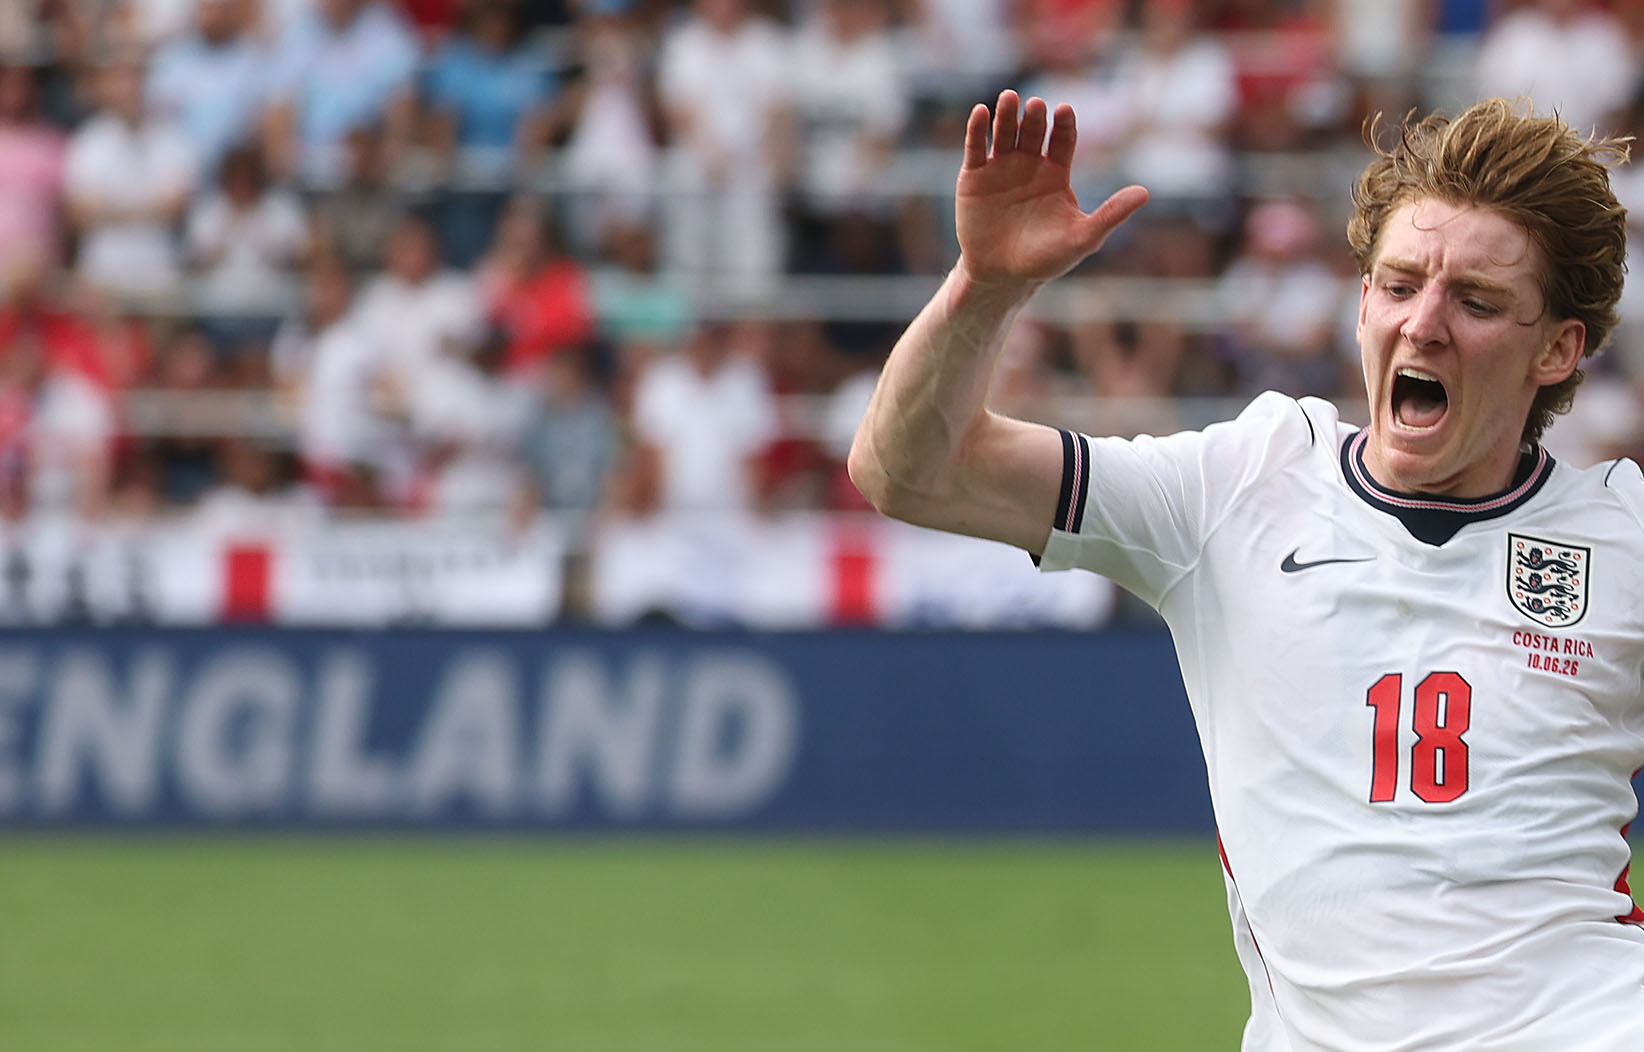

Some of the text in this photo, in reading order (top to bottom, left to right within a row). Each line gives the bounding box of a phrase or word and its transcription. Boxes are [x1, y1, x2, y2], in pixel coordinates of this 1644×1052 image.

[1512, 631, 1595, 658] COSTA RICA
[1527, 653, 1580, 676] 10.06.26
[1366, 671, 1472, 803] 18
